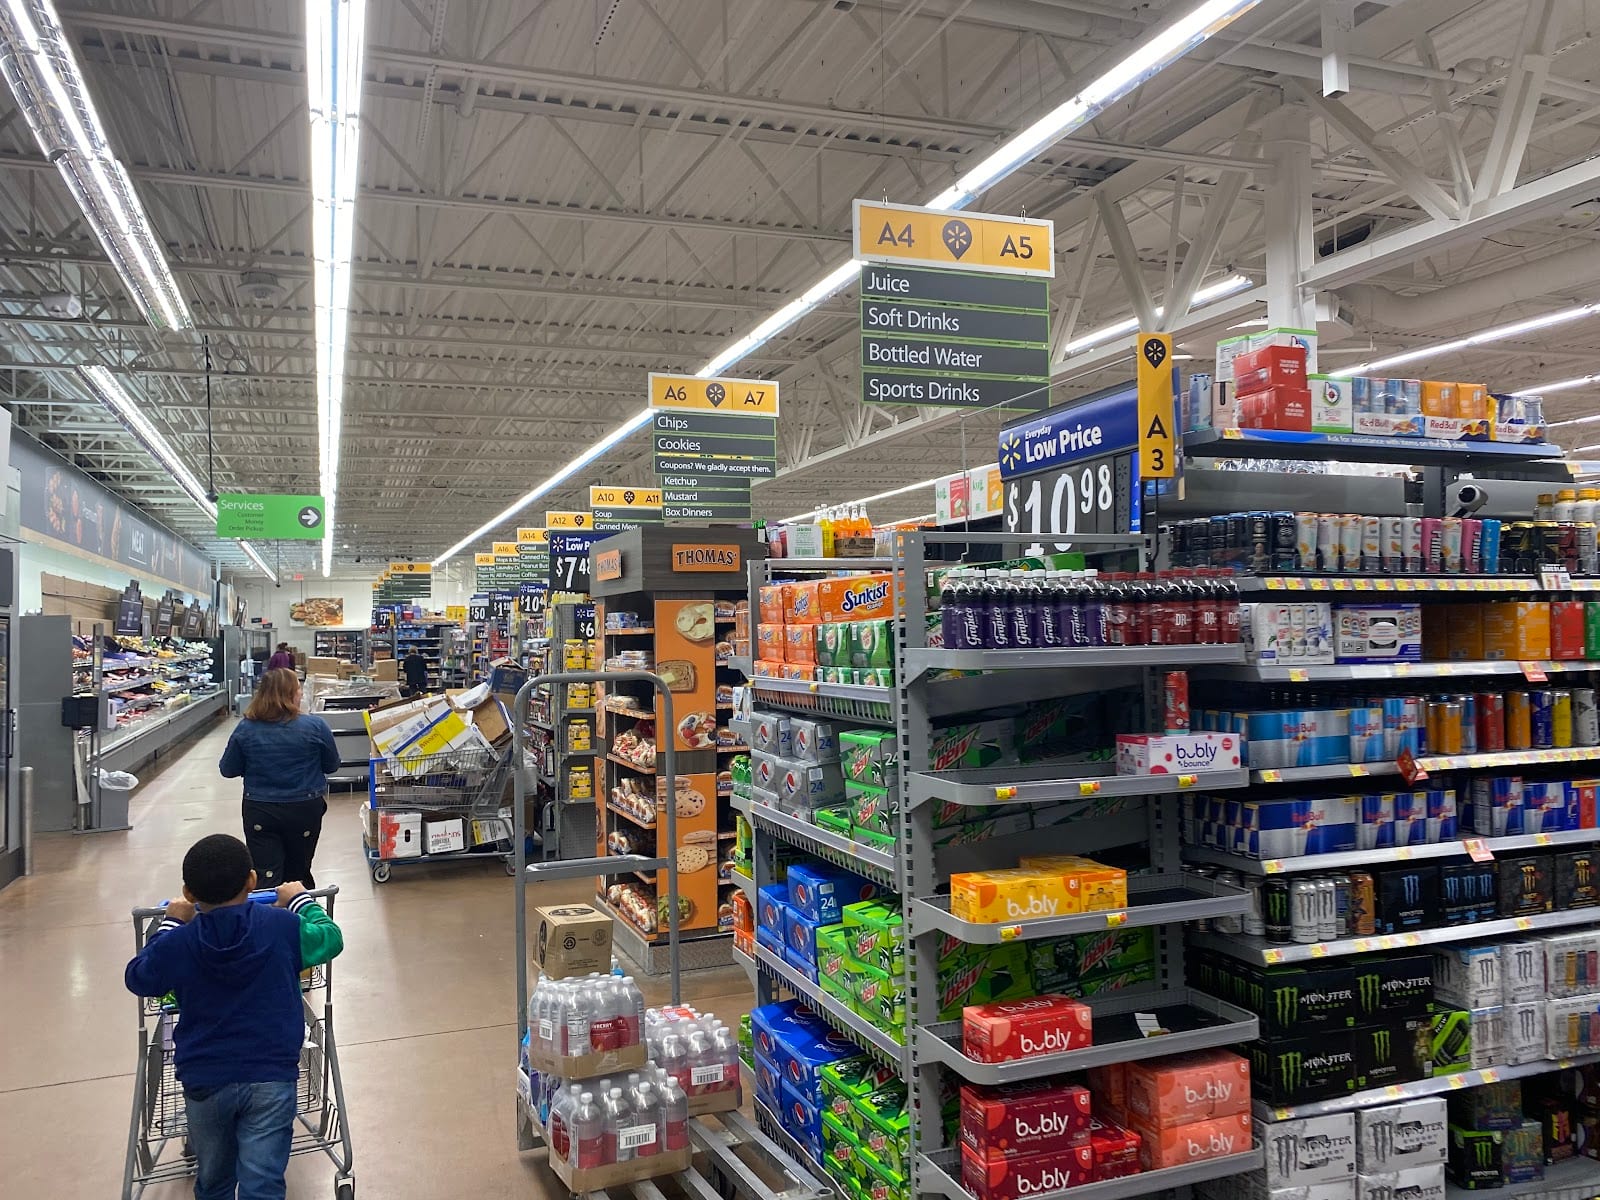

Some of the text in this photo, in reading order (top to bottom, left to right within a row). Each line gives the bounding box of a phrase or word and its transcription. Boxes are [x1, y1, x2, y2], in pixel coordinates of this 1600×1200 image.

[877, 221, 1033, 259] A4 A5
[868, 272, 910, 293] Juice
[869, 307, 960, 331] Soft Drinks
[869, 343, 983, 367] Bottled Water
[664, 385, 765, 406] A6 A7
[869, 378, 980, 402] Sports Drinks
[657, 416, 688, 430] Chips
[1025, 424, 1052, 440] Everyday
[657, 438, 701, 451] Cookies
[1025, 424, 1102, 463] Low Price
[659, 461, 771, 473] Coupons? We gladly accept them.
[664, 476, 698, 487] Ketchup
[597, 493, 659, 503] A10 A11
[664, 491, 698, 501] Mustard
[221, 500, 264, 511] Services
[665, 507, 713, 517] Box Dinners
[552, 517, 566, 525] A12
[595, 510, 612, 519] Soup
[566, 542, 583, 551] Low
[841, 581, 889, 612] Sunkist
[964, 607, 982, 646] Grapico
[1015, 607, 1032, 645] Grapico
[781, 733, 792, 743] 24
[819, 738, 832, 749] 24
[1176, 742, 1217, 762] bubly
[1183, 760, 1210, 768] bounce
[810, 781, 824, 793] 24
[820, 896, 834, 910] 24
[1006, 894, 1058, 917] bubly
[1381, 977, 1432, 991] MONSTER
[1300, 989, 1352, 1005] MONSTER
[1434, 1016, 1448, 1034] NEW
[1020, 1028, 1072, 1053] bubly
[1303, 1053, 1352, 1069] MONSTER
[1184, 1080, 1232, 1103] bubly
[1015, 1111, 1069, 1137] bubly
[1187, 1132, 1234, 1156] bubly
[1298, 1136, 1353, 1154] MONSTER
[1017, 1167, 1070, 1194] bubly
